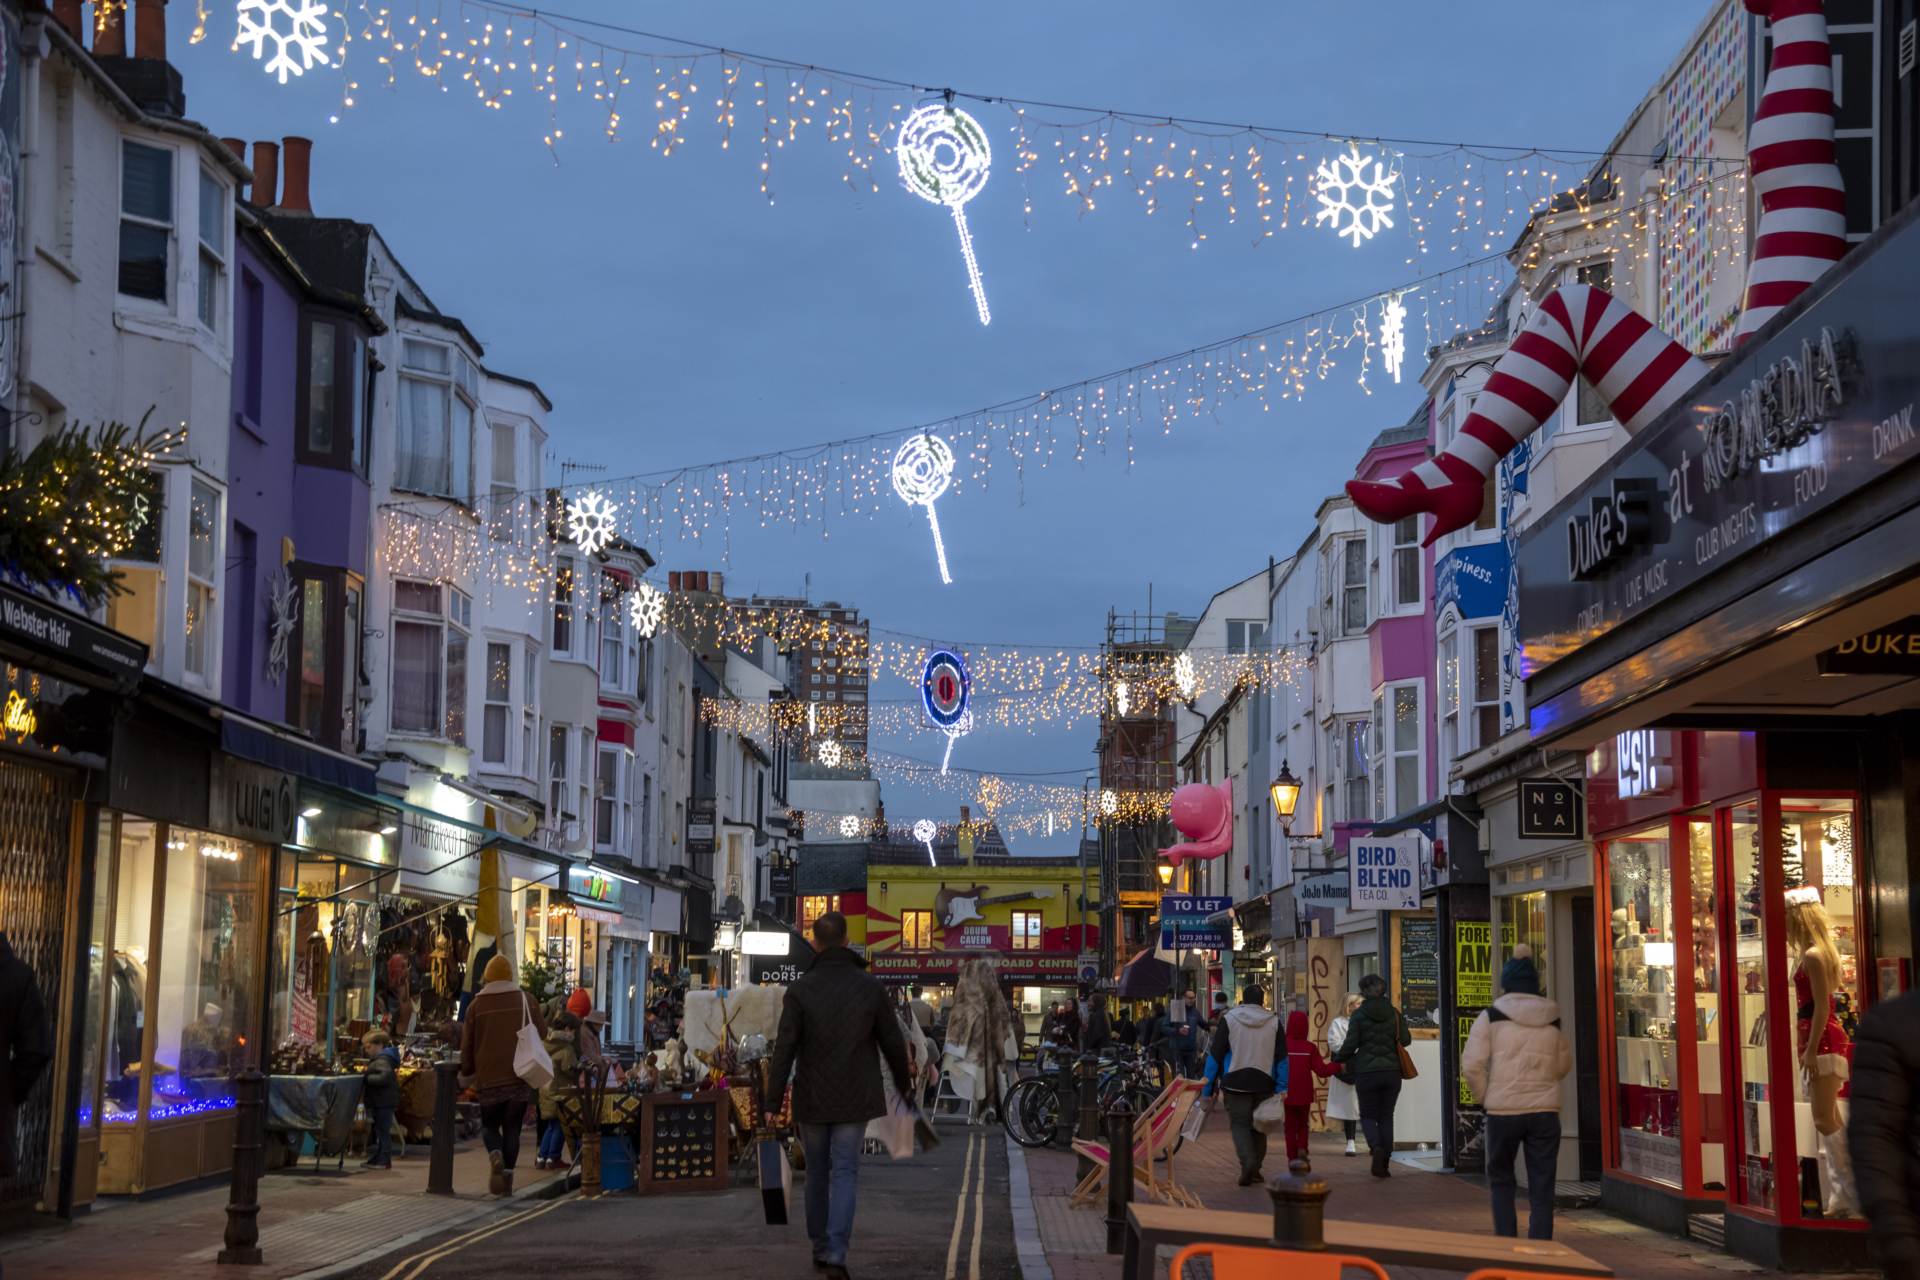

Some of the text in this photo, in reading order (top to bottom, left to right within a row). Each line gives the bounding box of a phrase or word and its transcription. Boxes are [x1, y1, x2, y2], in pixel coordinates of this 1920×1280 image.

[1567, 326, 1841, 581] Duke's at KOMEDIA
[1626, 575, 1642, 608] LIVE
[1644, 559, 1668, 596] MUSIC
[1695, 527, 1719, 566] CLUB
[1720, 502, 1756, 550] NIGHTS
[1794, 460, 1827, 507] FOOD
[1871, 404, 1916, 460] DRINK
[3, 599, 71, 648] Webster Hair
[235, 781, 275, 833] LUIGI
[1357, 846, 1412, 866] BIRD &
[1357, 868, 1411, 888] BLEND
[1301, 884, 1321, 899] JoJo
[1358, 889, 1375, 900] TEA
[1173, 901, 1221, 911] TO LET
[959, 935, 992, 945] CAVERN
[875, 959, 922, 968] GUITAR,
[926, 959, 953, 968] AMP
